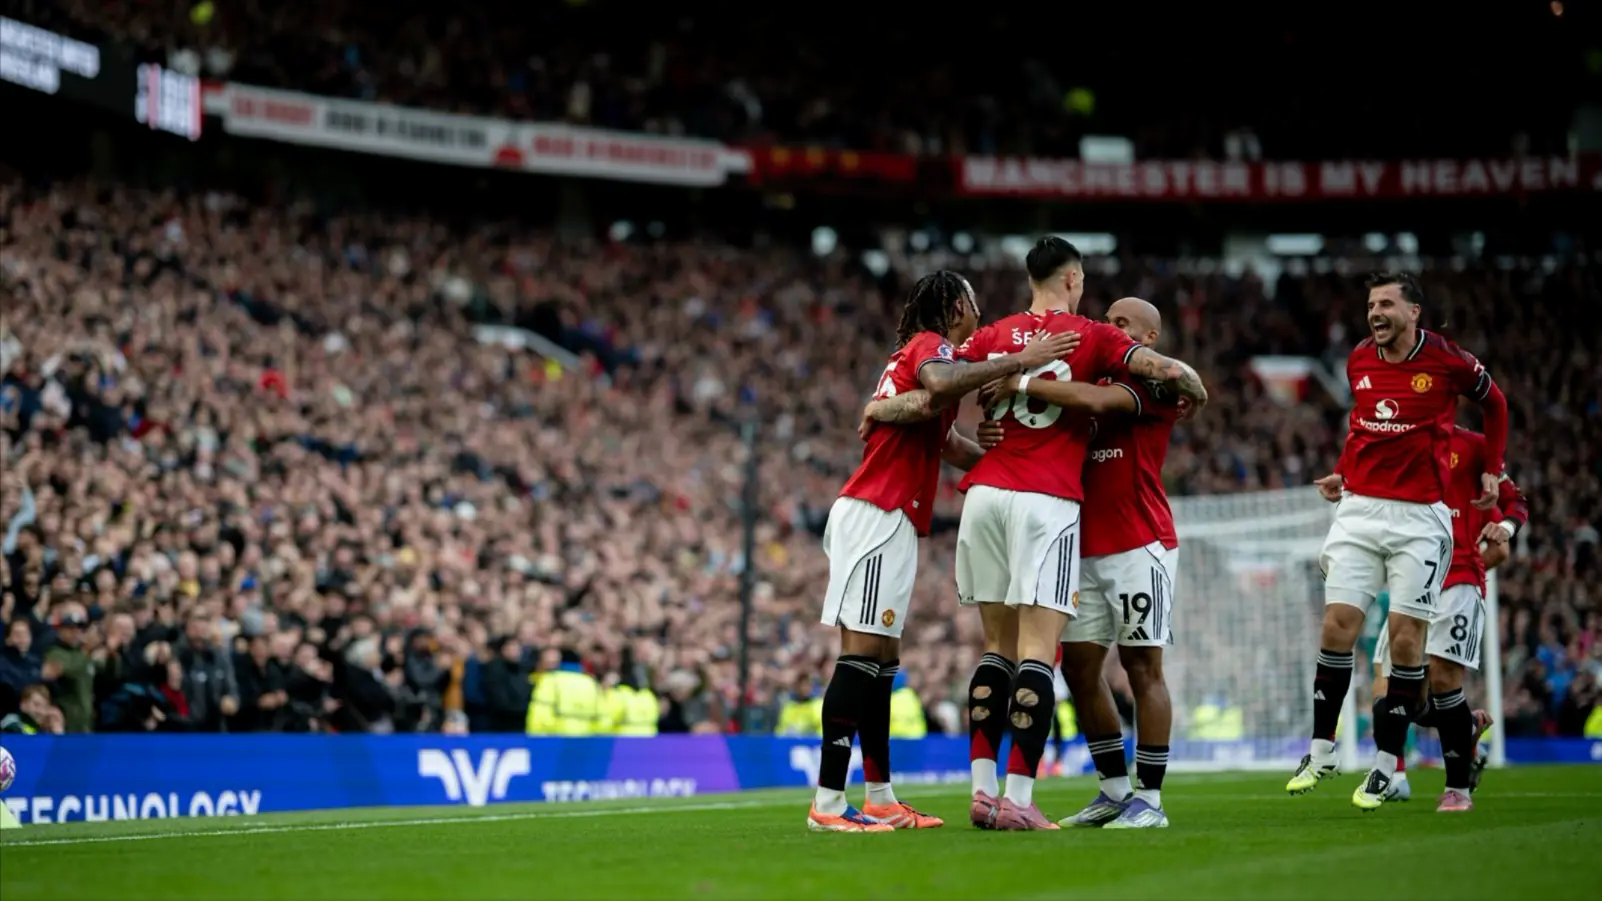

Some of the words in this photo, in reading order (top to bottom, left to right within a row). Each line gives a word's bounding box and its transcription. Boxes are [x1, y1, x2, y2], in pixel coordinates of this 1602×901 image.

[963, 157, 1249, 196] MANCHESTER
[1263, 161, 1306, 196] IS
[1321, 160, 1385, 195] MY
[1400, 155, 1579, 194] HEAVEN
[1424, 560, 1437, 589] 7
[1119, 592, 1152, 624] 19
[1450, 615, 1468, 642] 8
[4, 789, 262, 825] TECHNOLOGY
